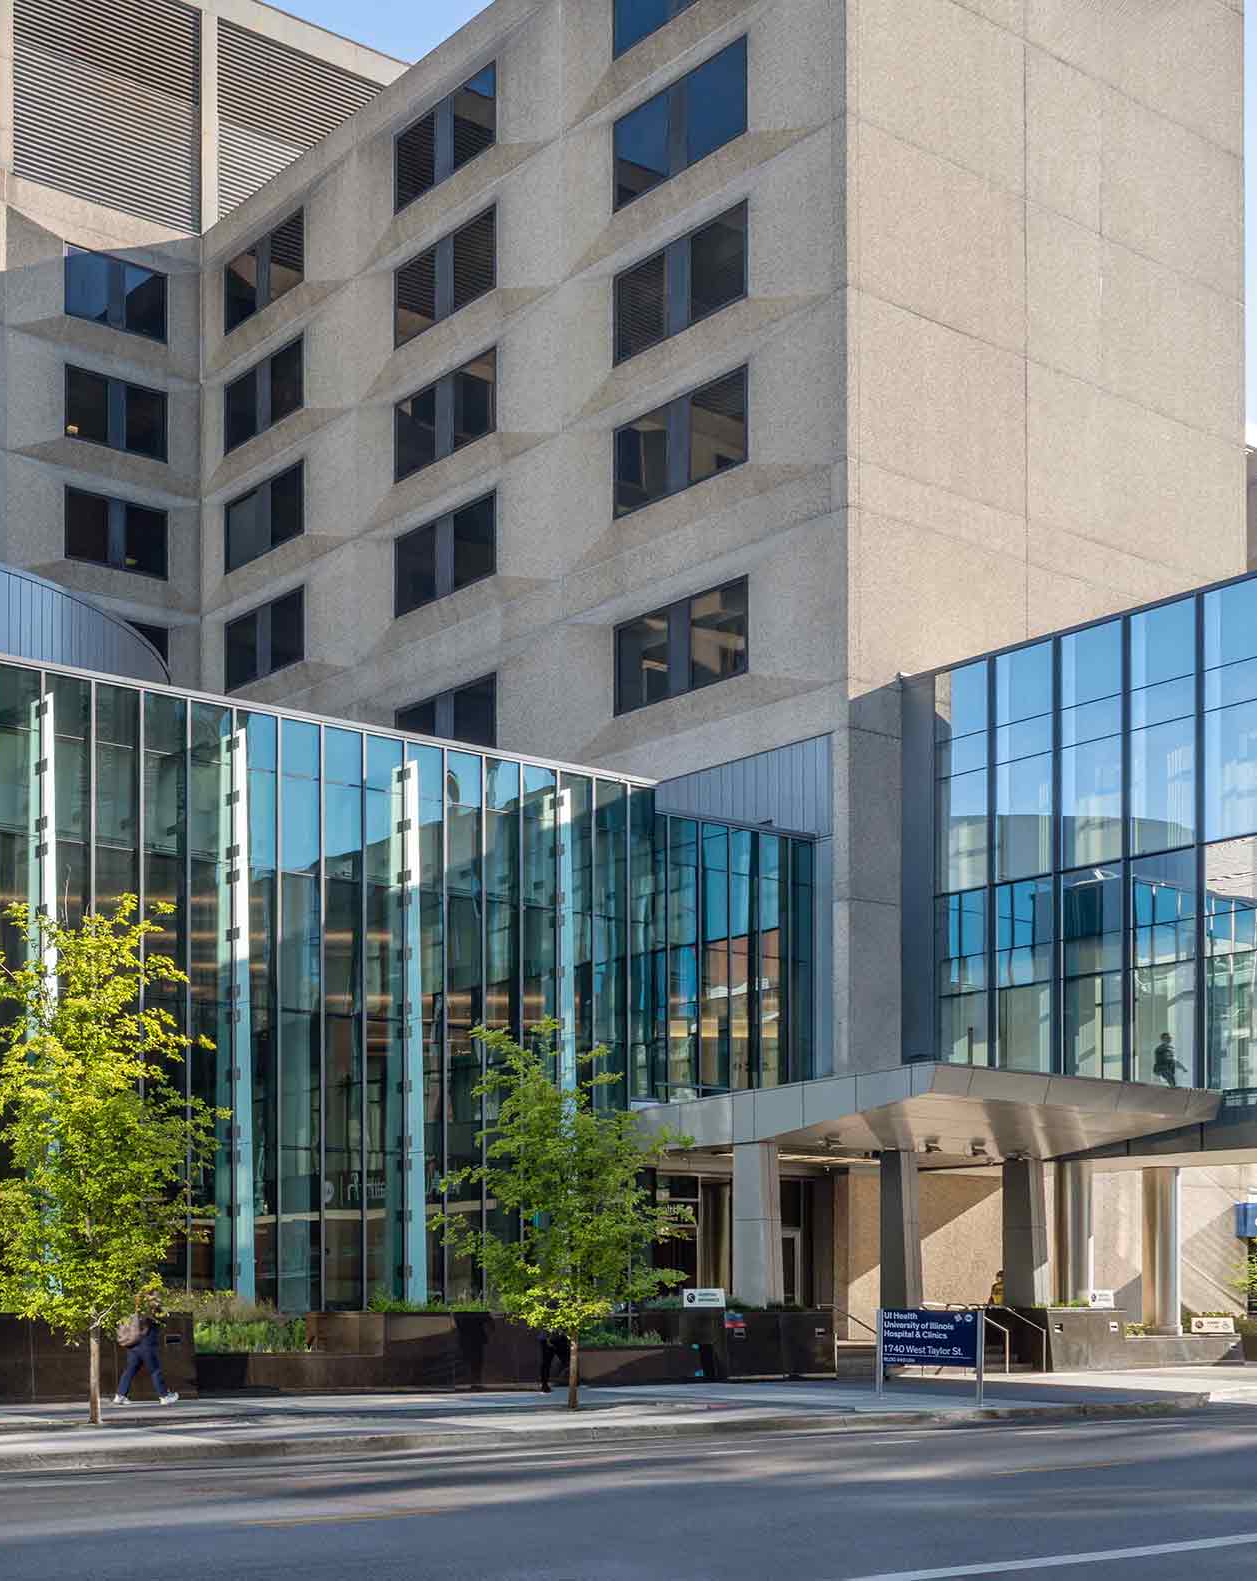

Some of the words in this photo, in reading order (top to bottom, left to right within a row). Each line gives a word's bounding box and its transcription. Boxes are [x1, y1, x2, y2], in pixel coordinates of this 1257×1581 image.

[884, 1312, 892, 1320] UI
[893, 1312, 918, 1320] Health
[884, 1321, 920, 1330] University
[920, 1322, 929, 1330] of
[929, 1322, 955, 1331] Illinois
[884, 1330, 915, 1339] Hospital
[922, 1331, 948, 1339] Clinics
[884, 1344, 905, 1353] 1740
[906, 1345, 926, 1354] West
[927, 1345, 951, 1356] Taylor
[952, 1346, 964, 1356] St.
